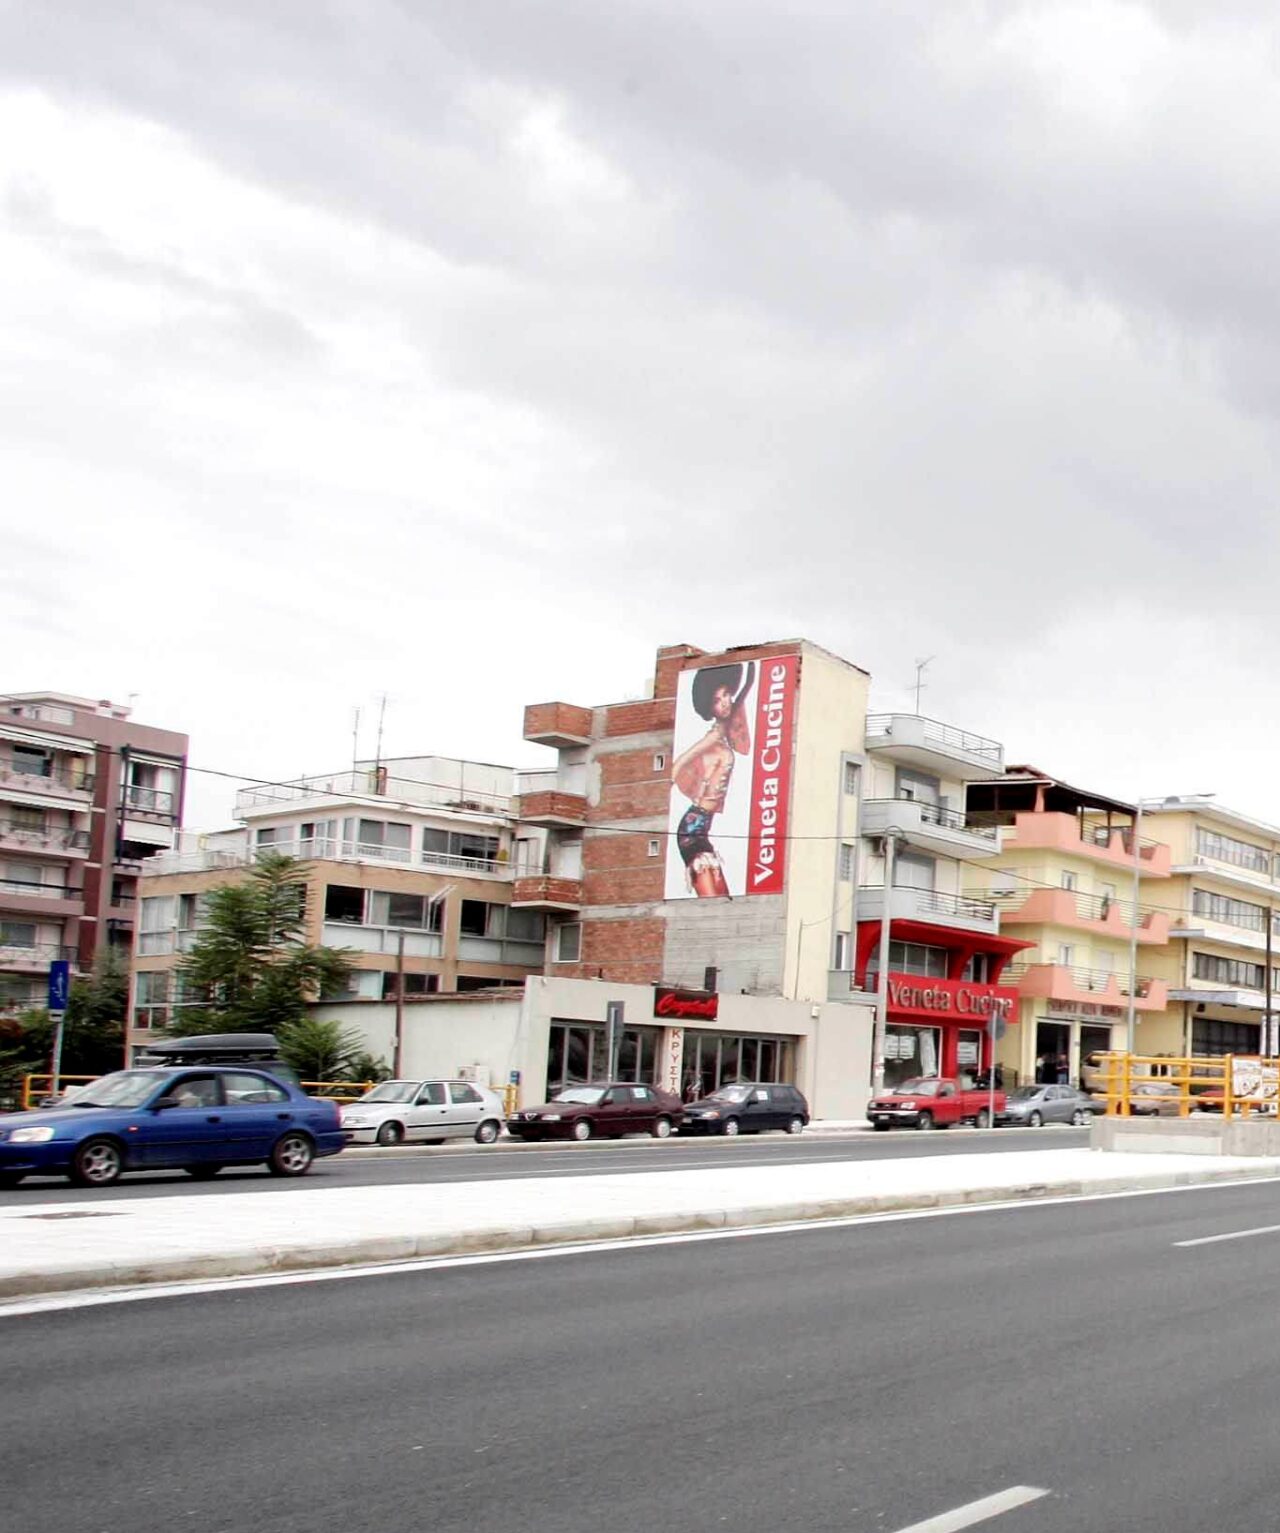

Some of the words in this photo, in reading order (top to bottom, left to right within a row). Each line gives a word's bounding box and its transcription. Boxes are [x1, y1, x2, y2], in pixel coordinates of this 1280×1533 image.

[760, 664, 787, 772] Cucine
[754, 777, 779, 886] Veneta
[887, 980, 950, 1011] Veneta
[955, 988, 1013, 1018] Cucine
